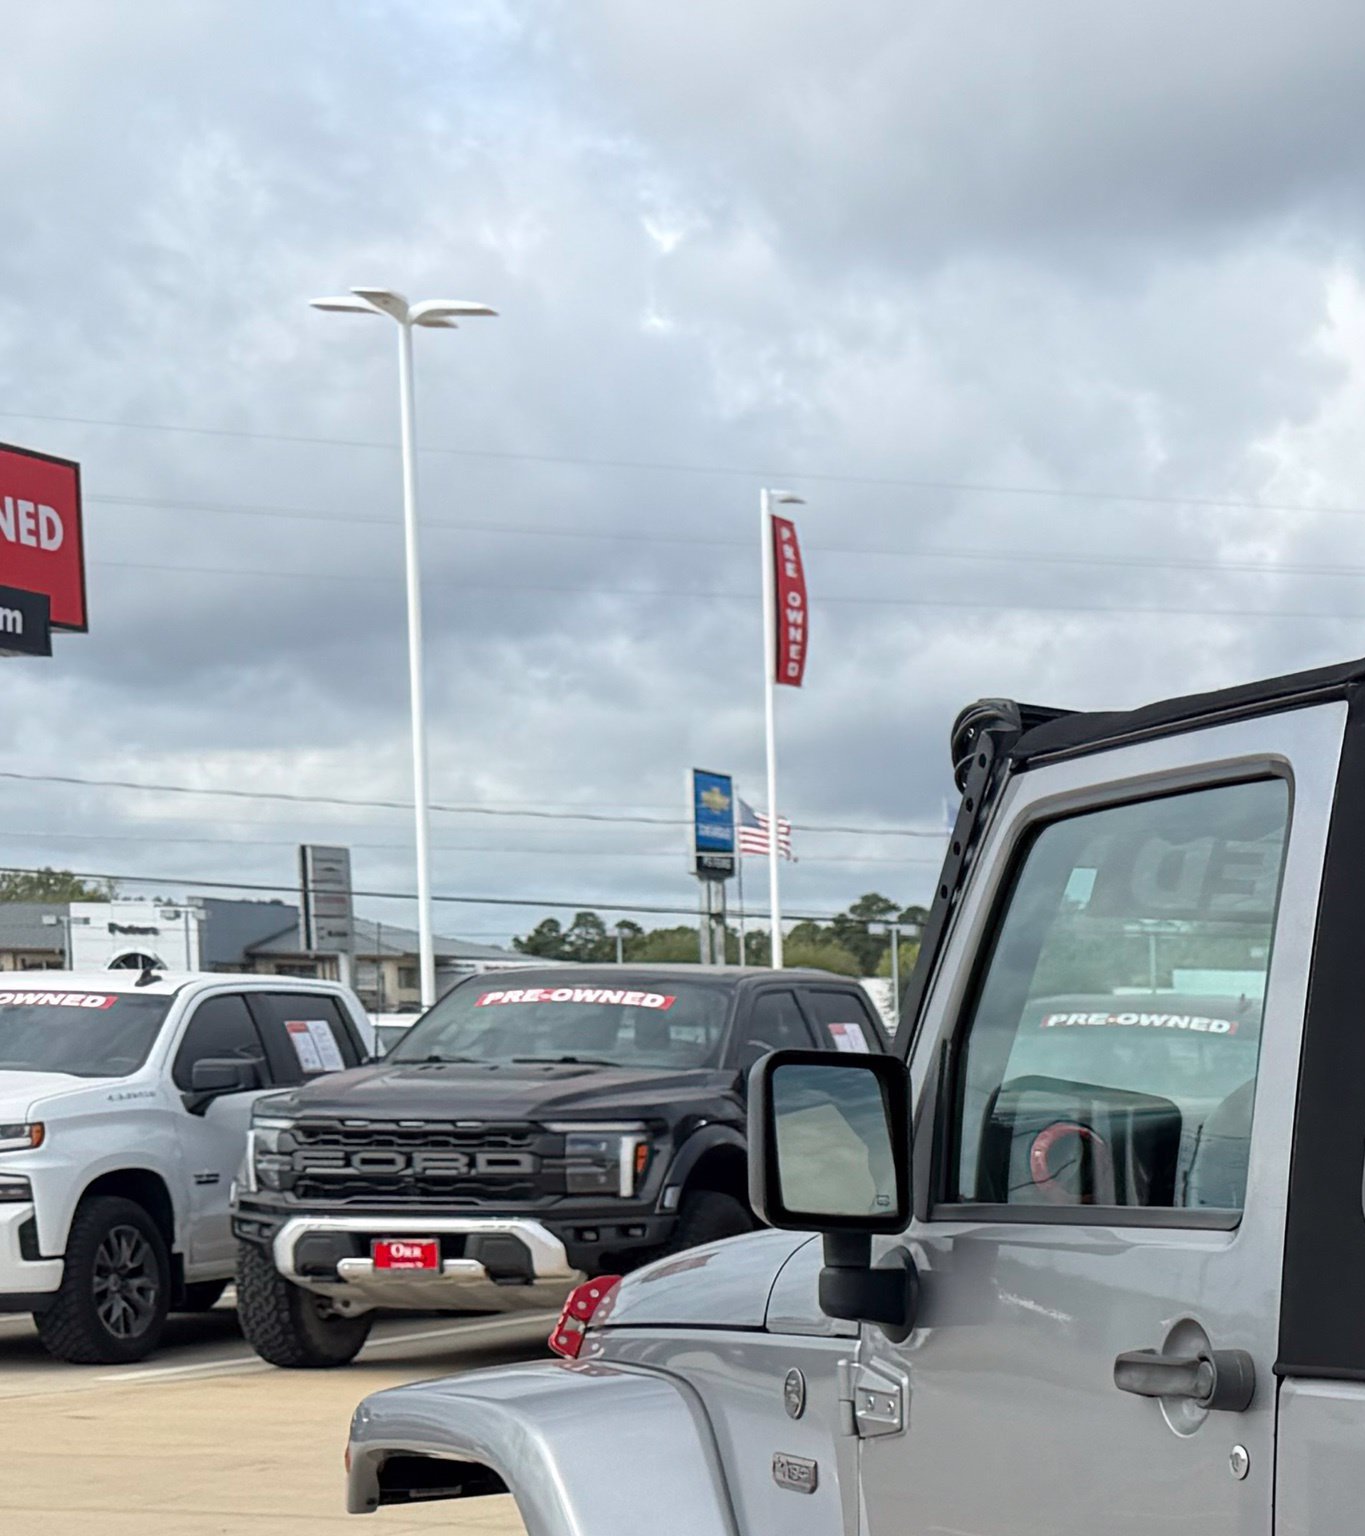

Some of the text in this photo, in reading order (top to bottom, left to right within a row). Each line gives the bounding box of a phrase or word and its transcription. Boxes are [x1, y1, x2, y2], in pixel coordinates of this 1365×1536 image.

[780, 527, 804, 677] PRE OWNED
[482, 988, 666, 1008] PRE-OWNED
[1047, 1012, 1231, 1034] PRE-OWNED
[293, 1151, 540, 1176] FORD
